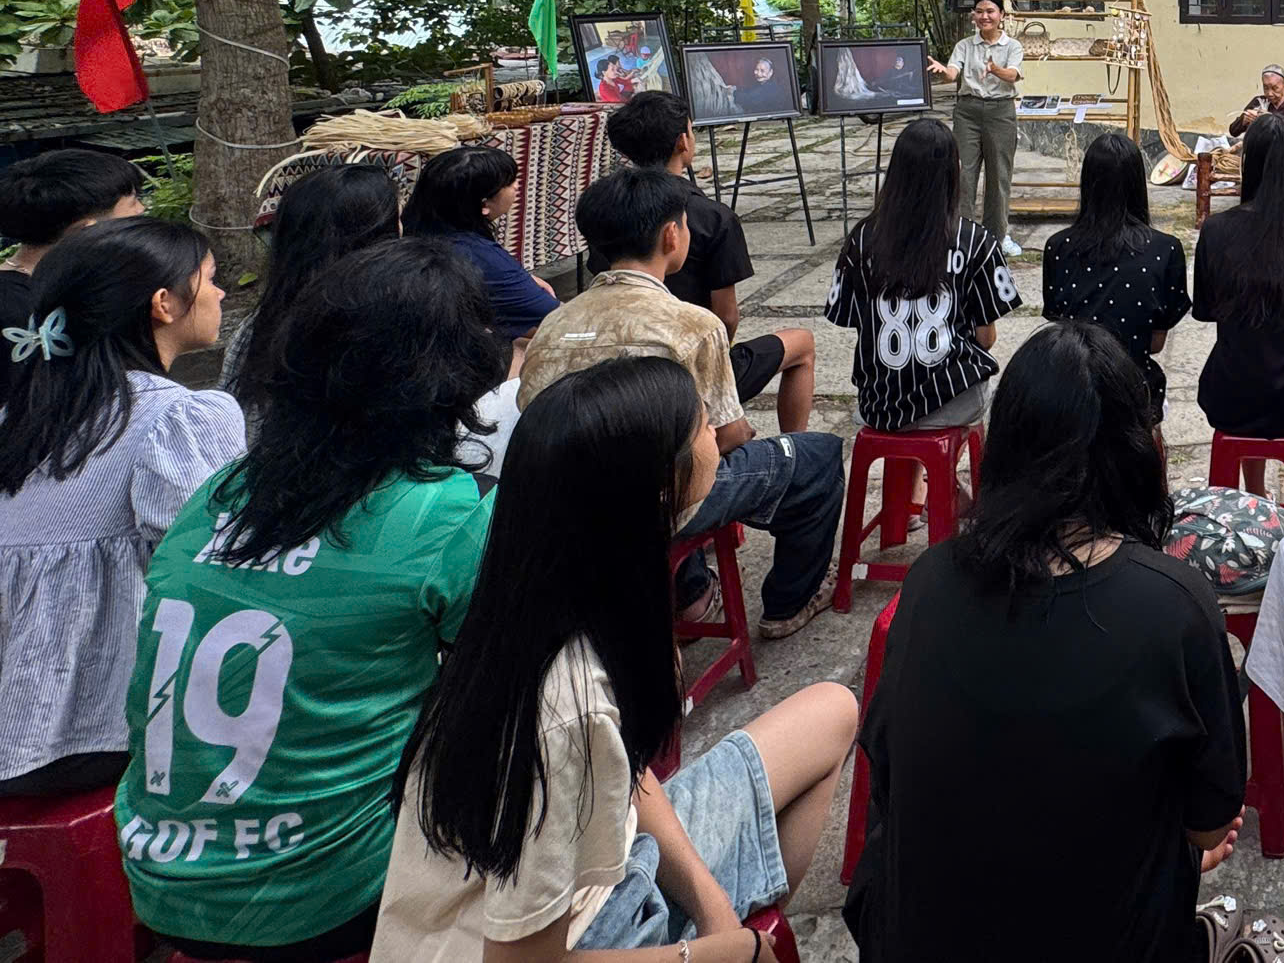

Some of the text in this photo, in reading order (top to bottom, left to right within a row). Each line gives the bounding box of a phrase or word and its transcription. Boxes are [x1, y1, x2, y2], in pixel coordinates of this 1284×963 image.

[877, 284, 953, 370] 88
[145, 597, 294, 805] 19
[234, 812, 305, 854] FC
